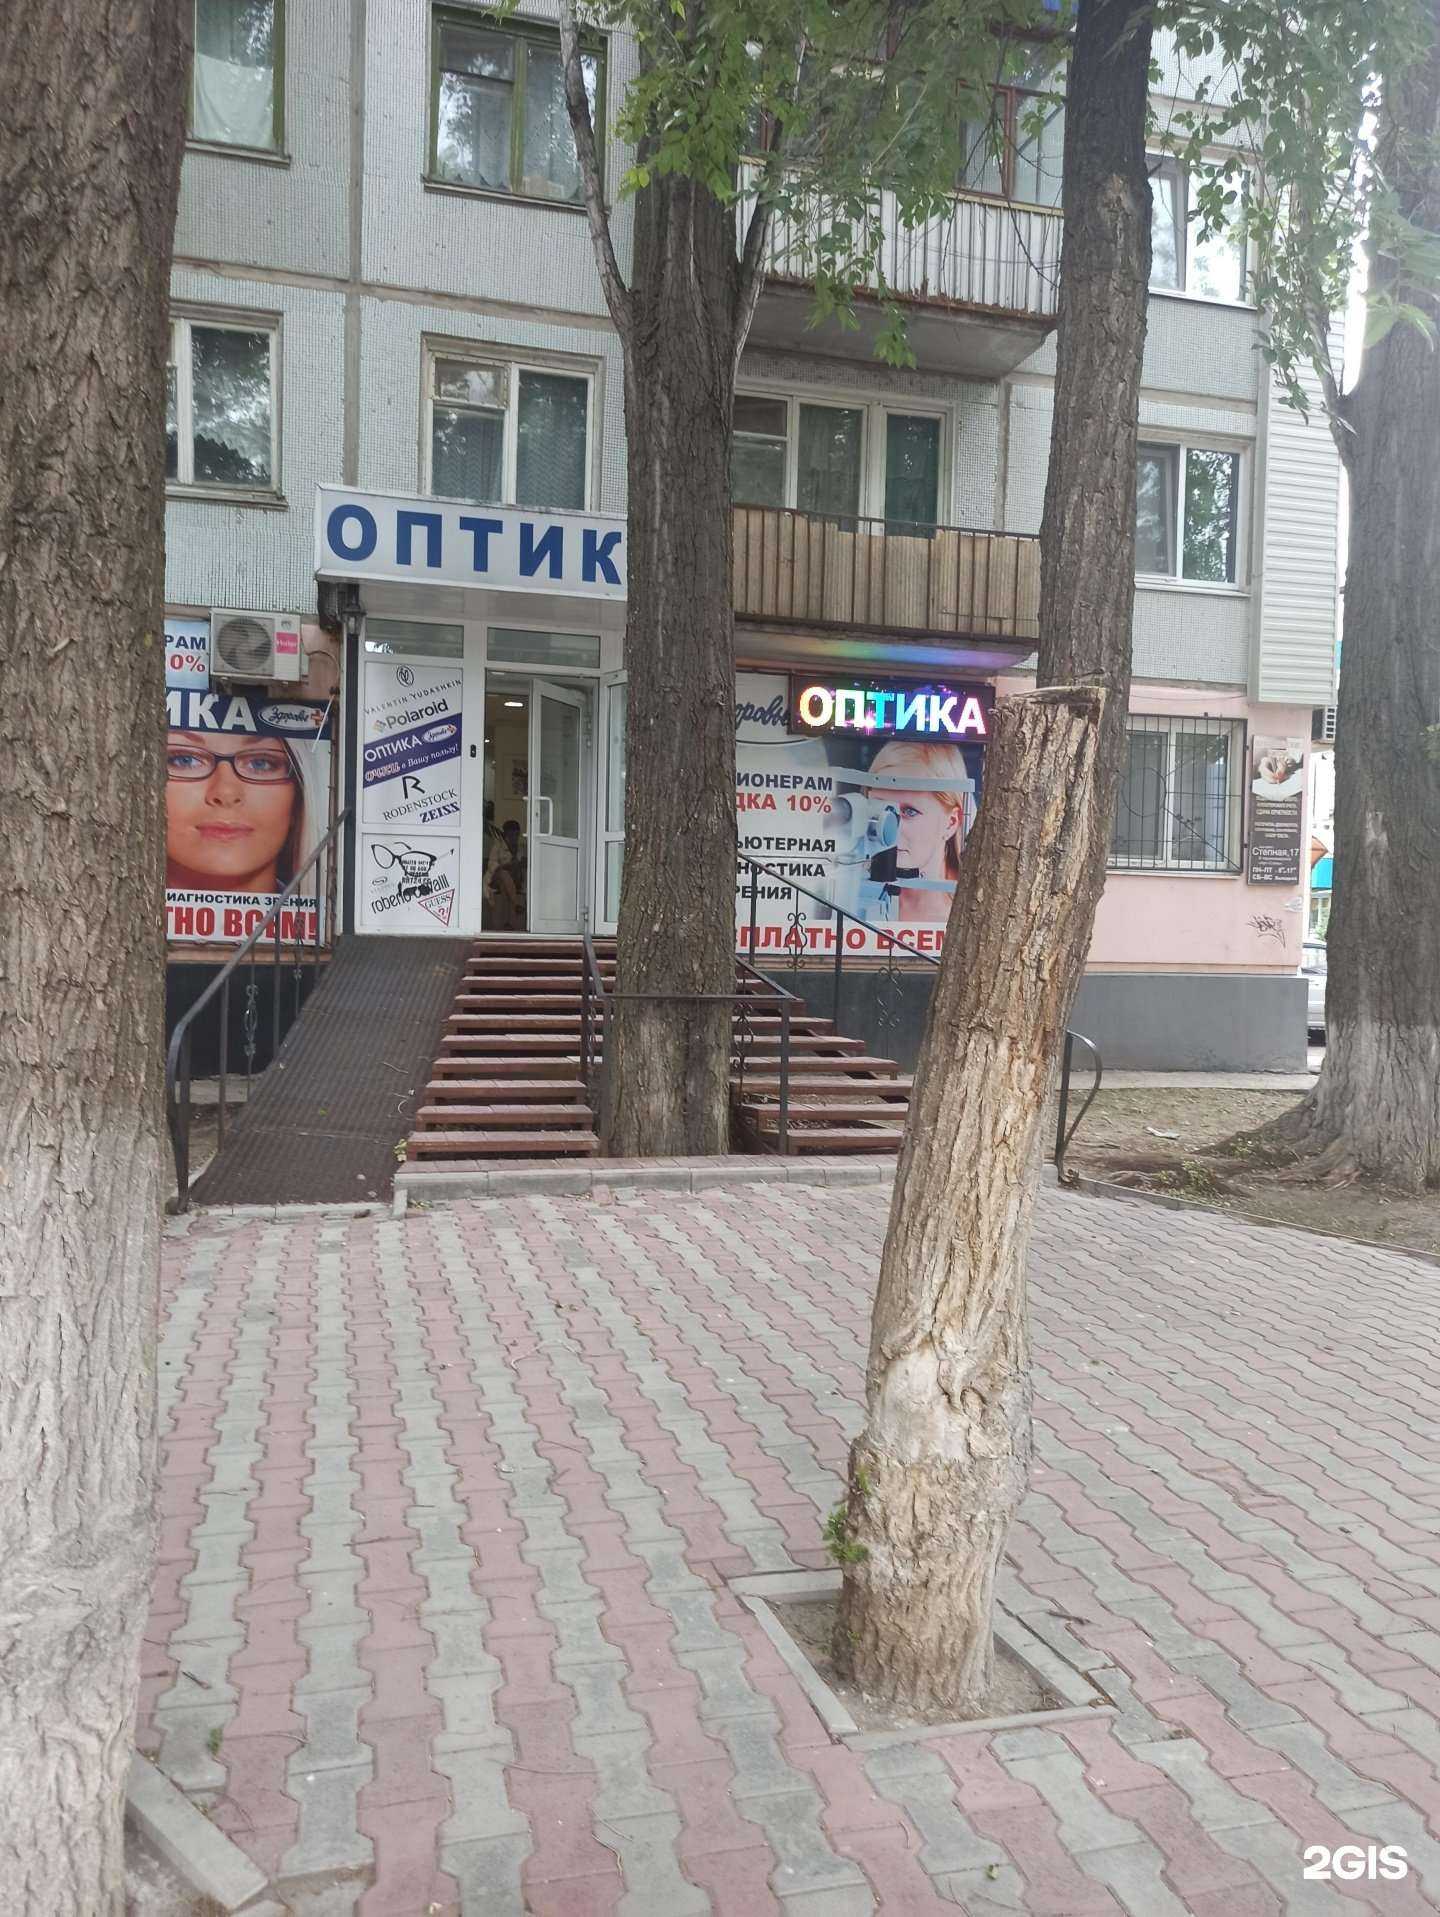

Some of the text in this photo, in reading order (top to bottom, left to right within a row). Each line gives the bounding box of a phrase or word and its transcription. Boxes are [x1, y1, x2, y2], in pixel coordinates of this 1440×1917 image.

[326, 503, 622, 585] ОПТИК
[386, 698, 449, 729] Polaroid
[799, 686, 987, 735] ОПТИКА
[364, 735, 422, 762] ОПТИКА
[737, 772, 833, 791] ИОНЕРАМ
[383, 788, 457, 820] RODENSTOCK
[419, 801, 461, 823] ZEISS
[787, 794, 832, 813] 10%
[167, 892, 261, 906] ИАГНОСТИКА
